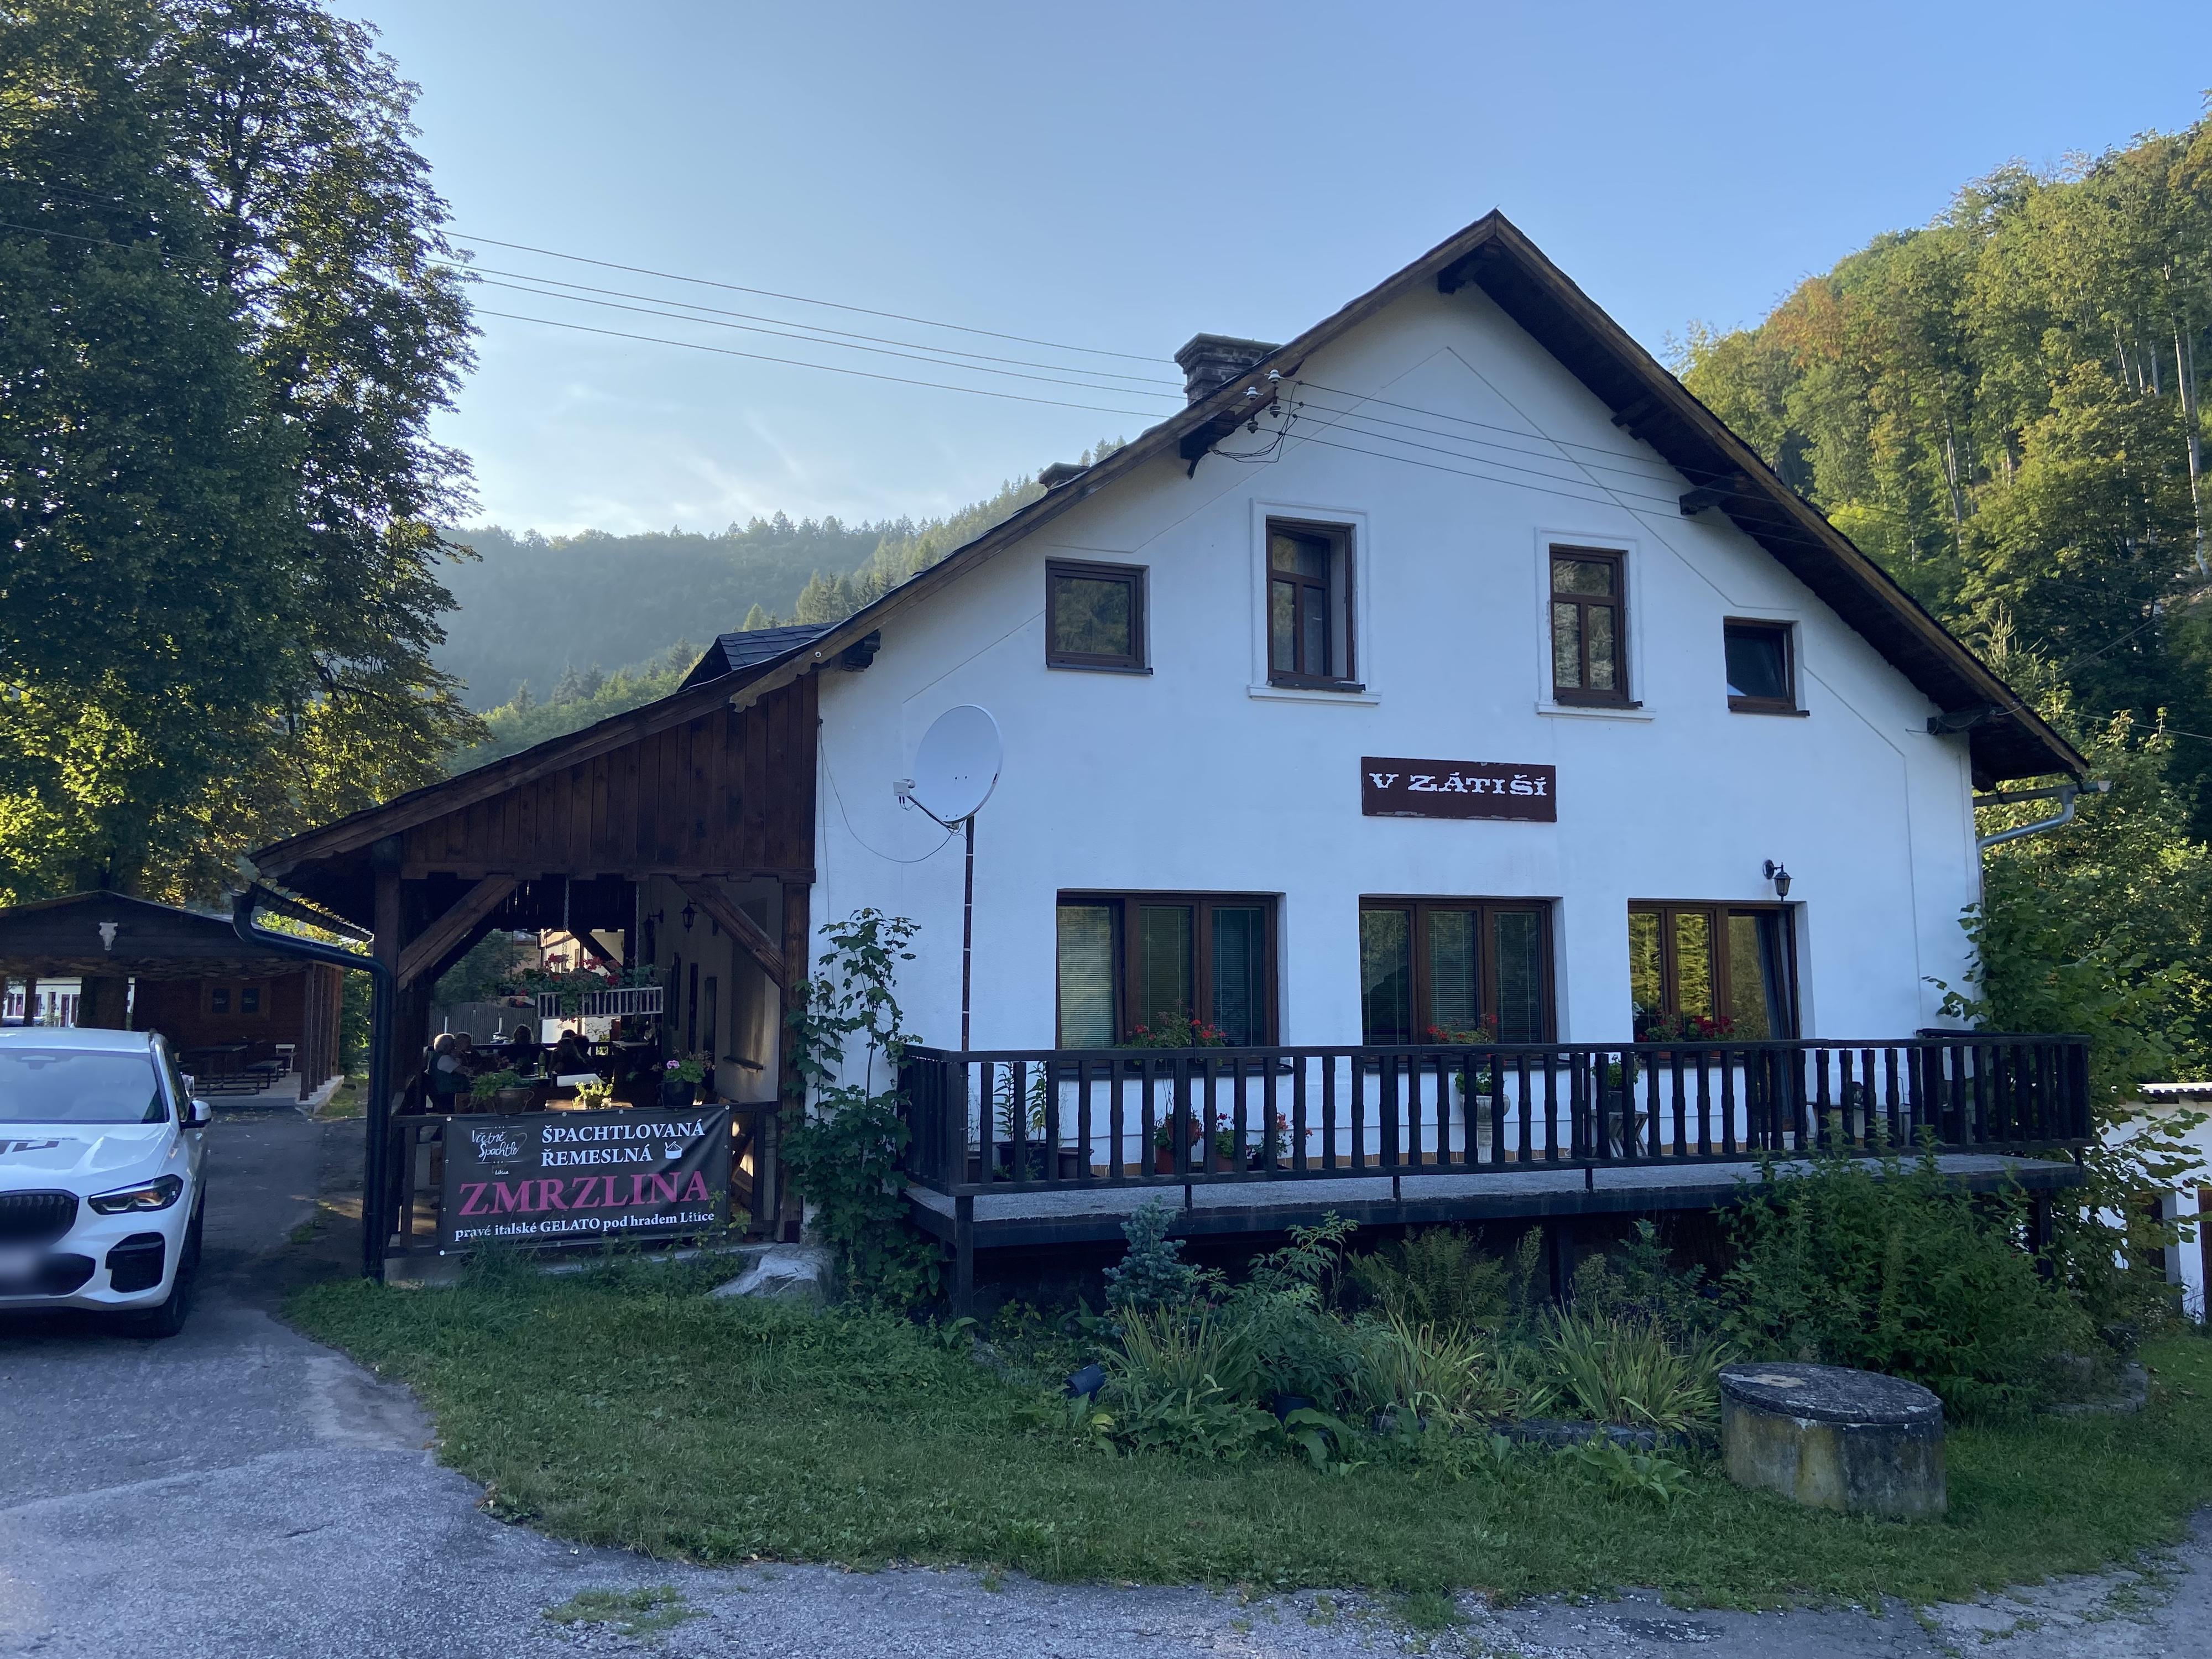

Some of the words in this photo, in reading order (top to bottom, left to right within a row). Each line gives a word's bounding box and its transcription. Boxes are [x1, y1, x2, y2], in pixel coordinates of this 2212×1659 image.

[1369, 773, 1399, 789] V
[1408, 771, 1547, 796] ZÁTIŠÍ
[541, 1118, 705, 1144] ŠPACHTLOVANÁ
[540, 1143, 654, 1167] ŘEMESLNÁ
[458, 1170, 711, 1216] ZMRZLINA
[455, 1224, 492, 1242] pravé
[494, 1222, 538, 1236] italské
[540, 1218, 601, 1232] GELATO
[602, 1215, 628, 1232] pod
[630, 1213, 677, 1227] hradem
[680, 1211, 715, 1223] Litice
